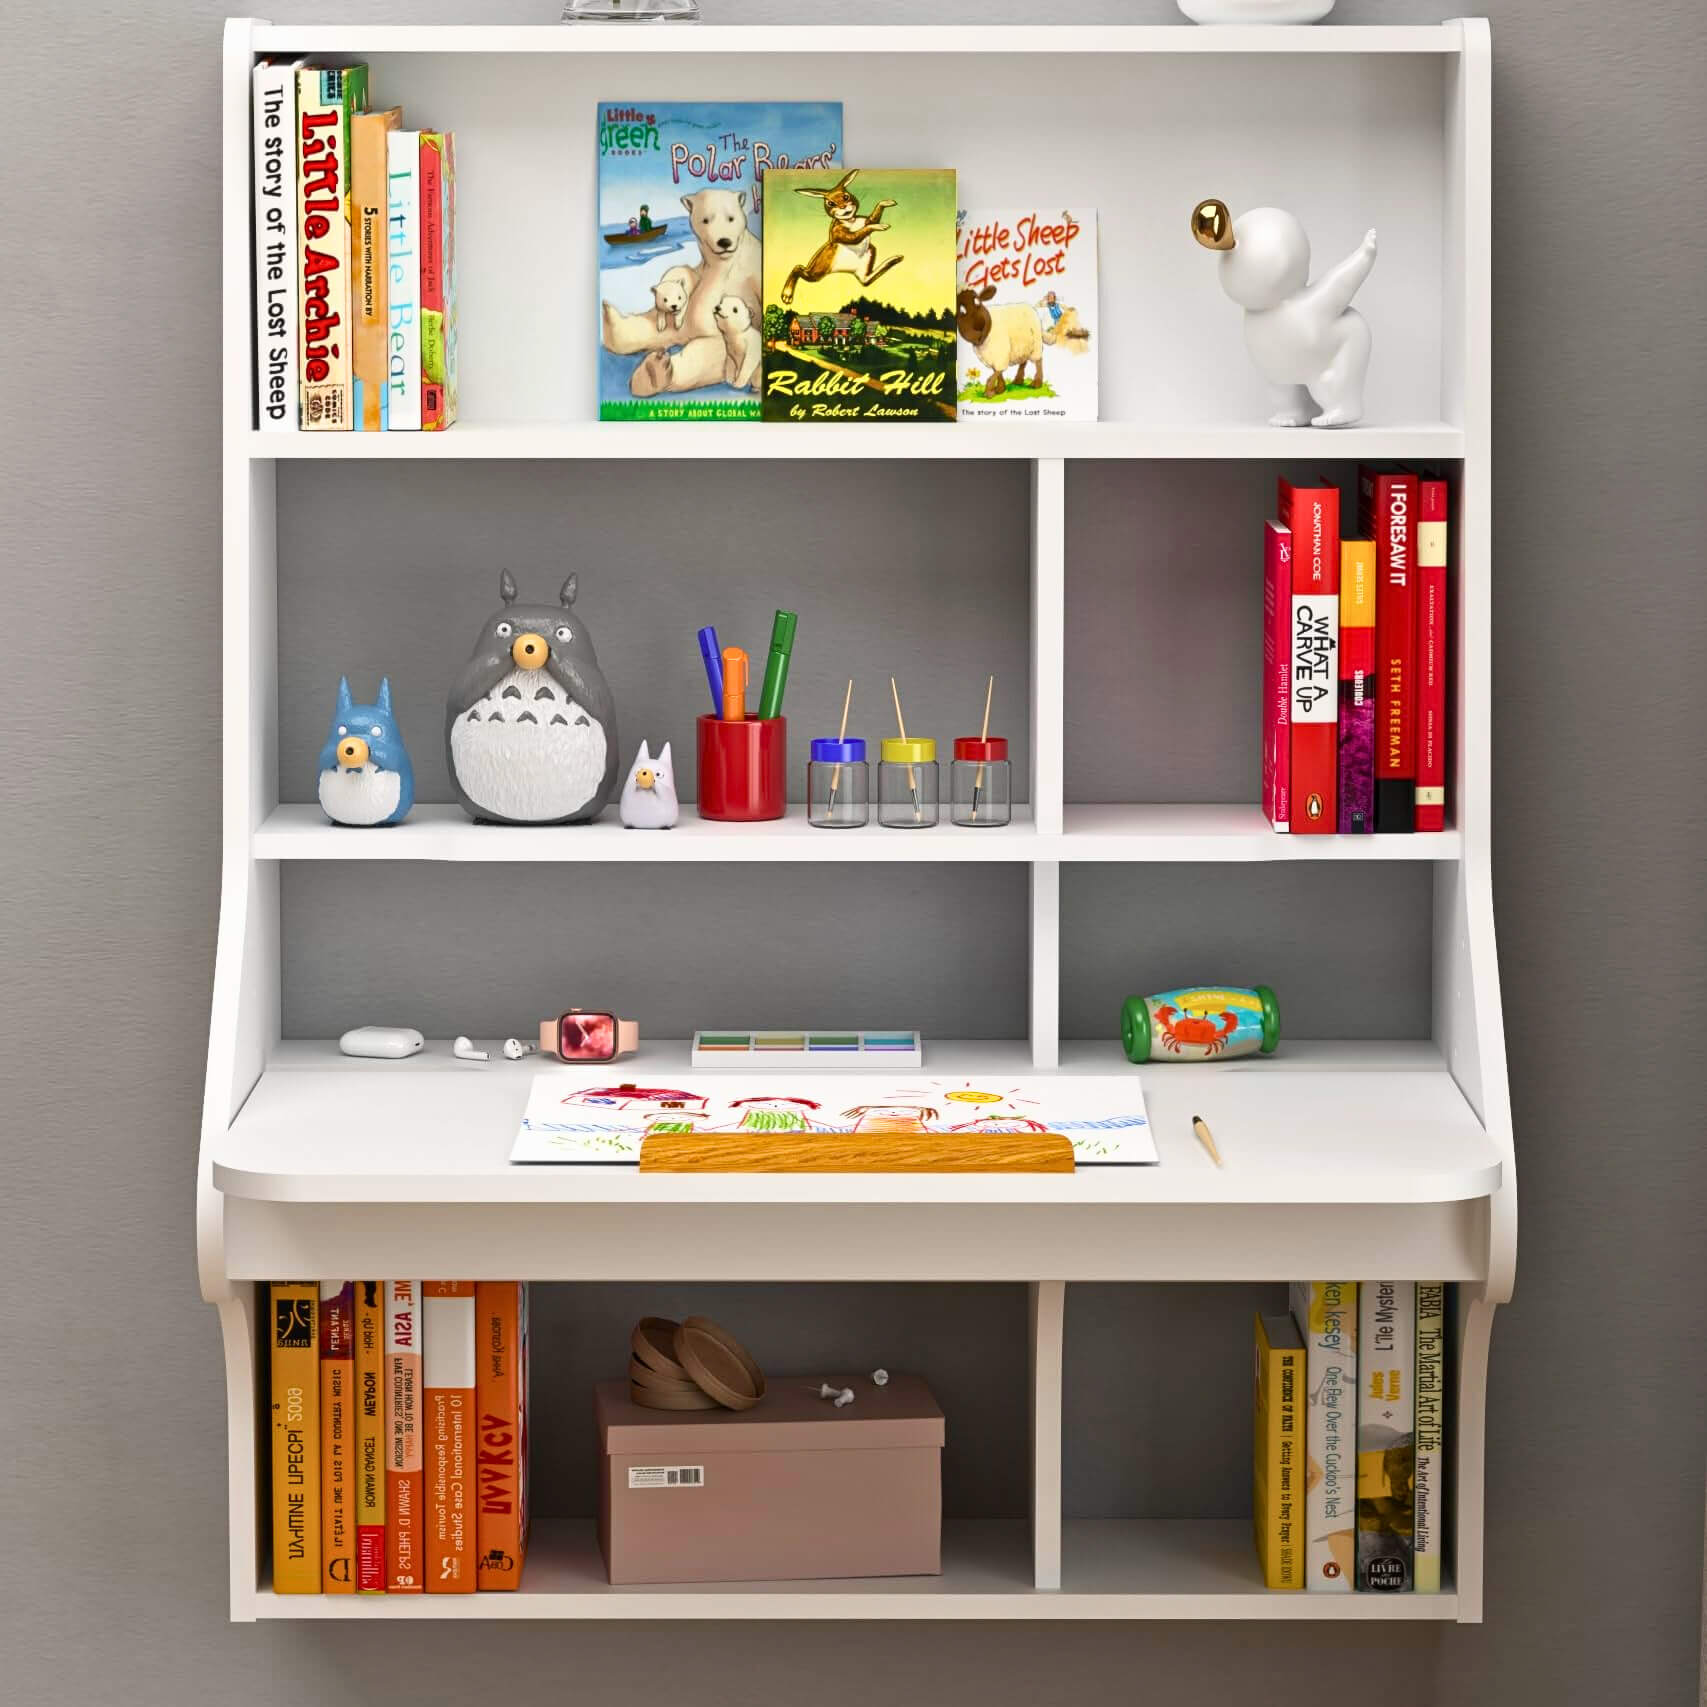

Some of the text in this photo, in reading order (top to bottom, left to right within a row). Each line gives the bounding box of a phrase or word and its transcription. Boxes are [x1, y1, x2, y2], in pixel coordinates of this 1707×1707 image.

[606, 107, 644, 122] Little
[600, 119, 660, 156] green
[718, 132, 751, 153] The
[302, 110, 339, 240] Little
[670, 142, 747, 184] Polar
[262, 84, 288, 420] The story of the Lost Sheep
[1013, 213, 1081, 253] Sheep
[364, 207, 379, 317] 5 STORIES WITH NARRATION BY
[965, 249, 1066, 288] Gets Lost
[389, 168, 413, 396] Little Bear
[303, 244, 341, 383] Archie
[767, 370, 947, 397] Rabbit Hill
[647, 409, 655, 417] A
[657, 409, 685, 417] STORY
[687, 409, 714, 417] ABOUT
[716, 409, 747, 417] GLOBAL
[790, 403, 920, 420] by Robert Lawson
[977, 409, 997, 418] story
[1043, 409, 1067, 418] Sheep
[1312, 502, 1322, 581] JONATHAN COE
[1390, 493, 1408, 570] FORESAW
[1390, 571, 1407, 587] IT
[1296, 605, 1313, 712] CARVE UP
[1313, 616, 1330, 701] WHAT A
[1277, 663, 1289, 725] Double Hamlet
[1354, 669, 1364, 706] COULEURS
[1390, 658, 1402, 768] SETH FREEMAN
[1318, 1281, 1348, 1350] ken kesey
[1326, 1366, 1342, 1386] One
[1368, 1372, 1384, 1400] Jules
[1384, 1370, 1401, 1401] Verne
[1418, 1286, 1442, 1451] FABIA The Martial Art of Life
[1326, 1411, 1341, 1433] Over
[1280, 1441, 1293, 1464] Getting
[1326, 1435, 1341, 1451] the
[1326, 1453, 1342, 1494] Cuckoo's
[1279, 1503, 1293, 1520] Every
[1325, 1497, 1341, 1519] Nest
[1414, 1456, 1430, 1552] The Art of Intentional Living
[1371, 1564, 1401, 1573] LIVRE
